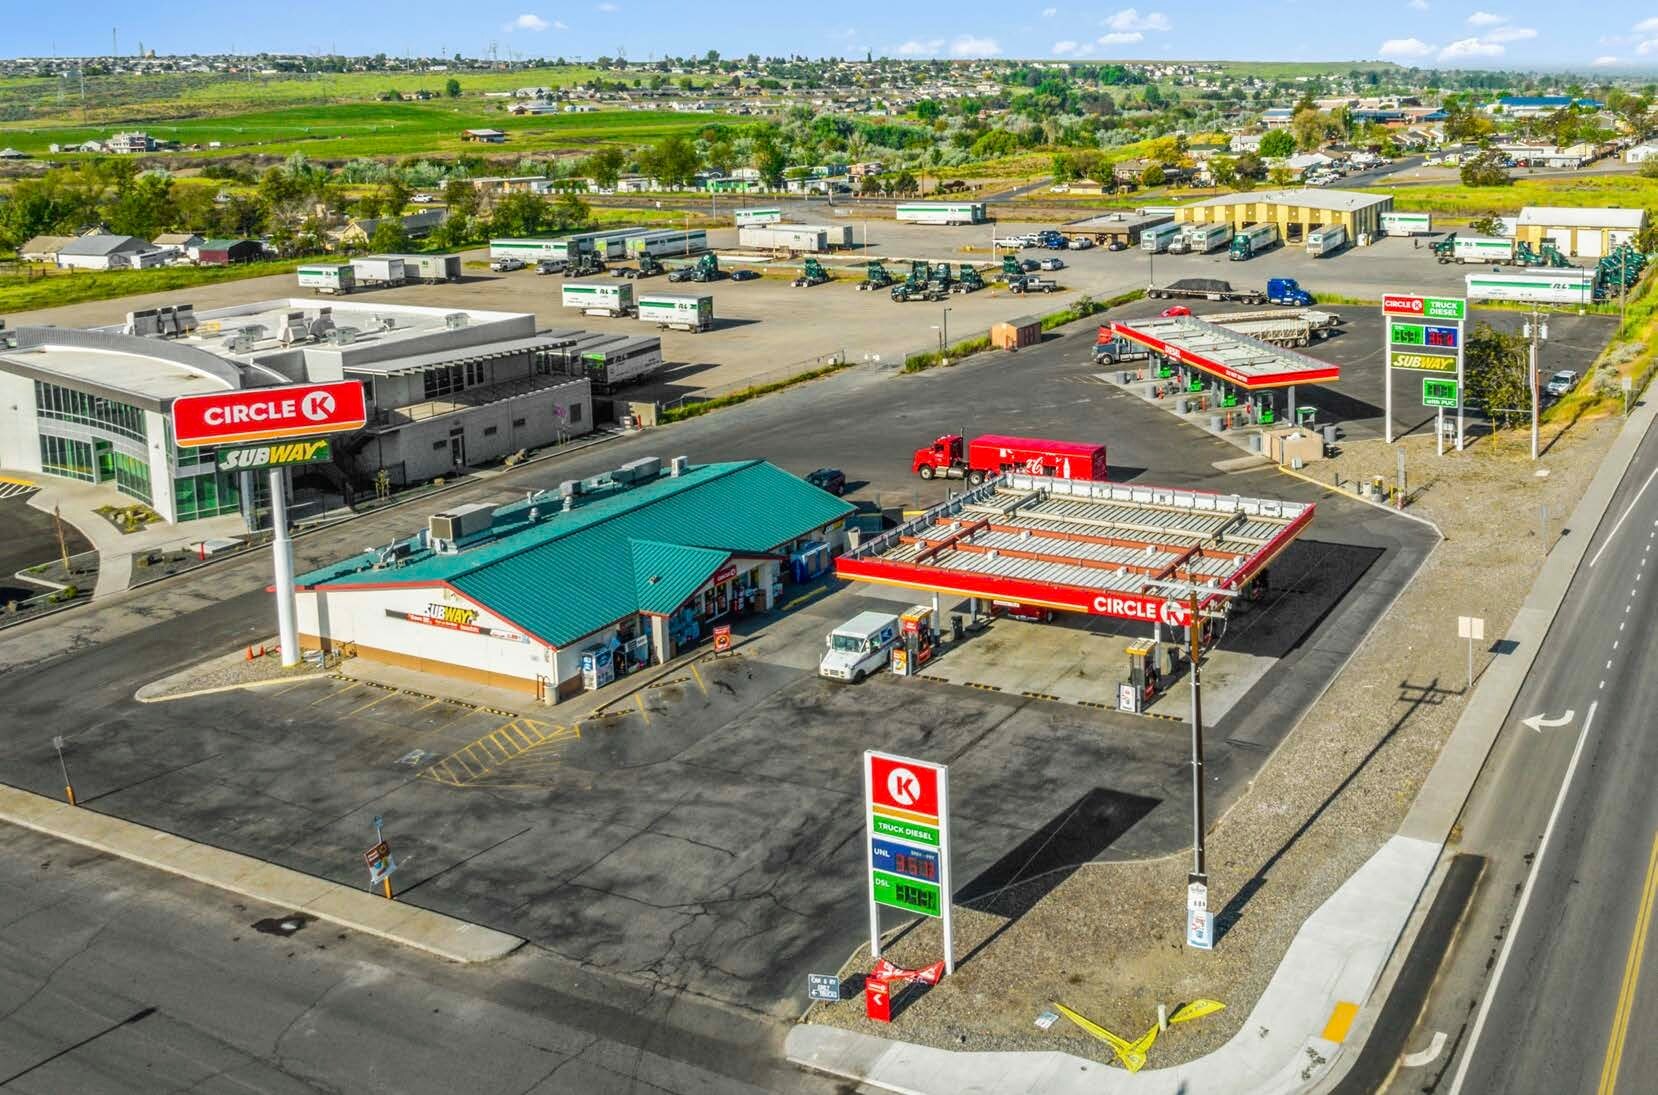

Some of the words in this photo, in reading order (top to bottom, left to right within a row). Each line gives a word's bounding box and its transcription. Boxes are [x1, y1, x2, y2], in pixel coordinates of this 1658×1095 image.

[1385, 300, 1411, 308] CIRCLE
[1430, 308, 1457, 316] DIESEL
[1393, 355, 1454, 370] SUBWAY
[204, 399, 297, 426] CIRCLE
[305, 393, 335, 421] K
[219, 440, 327, 470] SUBWAY
[424, 603, 479, 625] SUBWAY
[1094, 597, 1156, 618] CIRCLE
[890, 770, 920, 806] K
[878, 822, 904, 833] TRUCK
[905, 828, 932, 840] DIESEL
[874, 848, 891, 858] UNL
[875, 878, 890, 887] DSL
